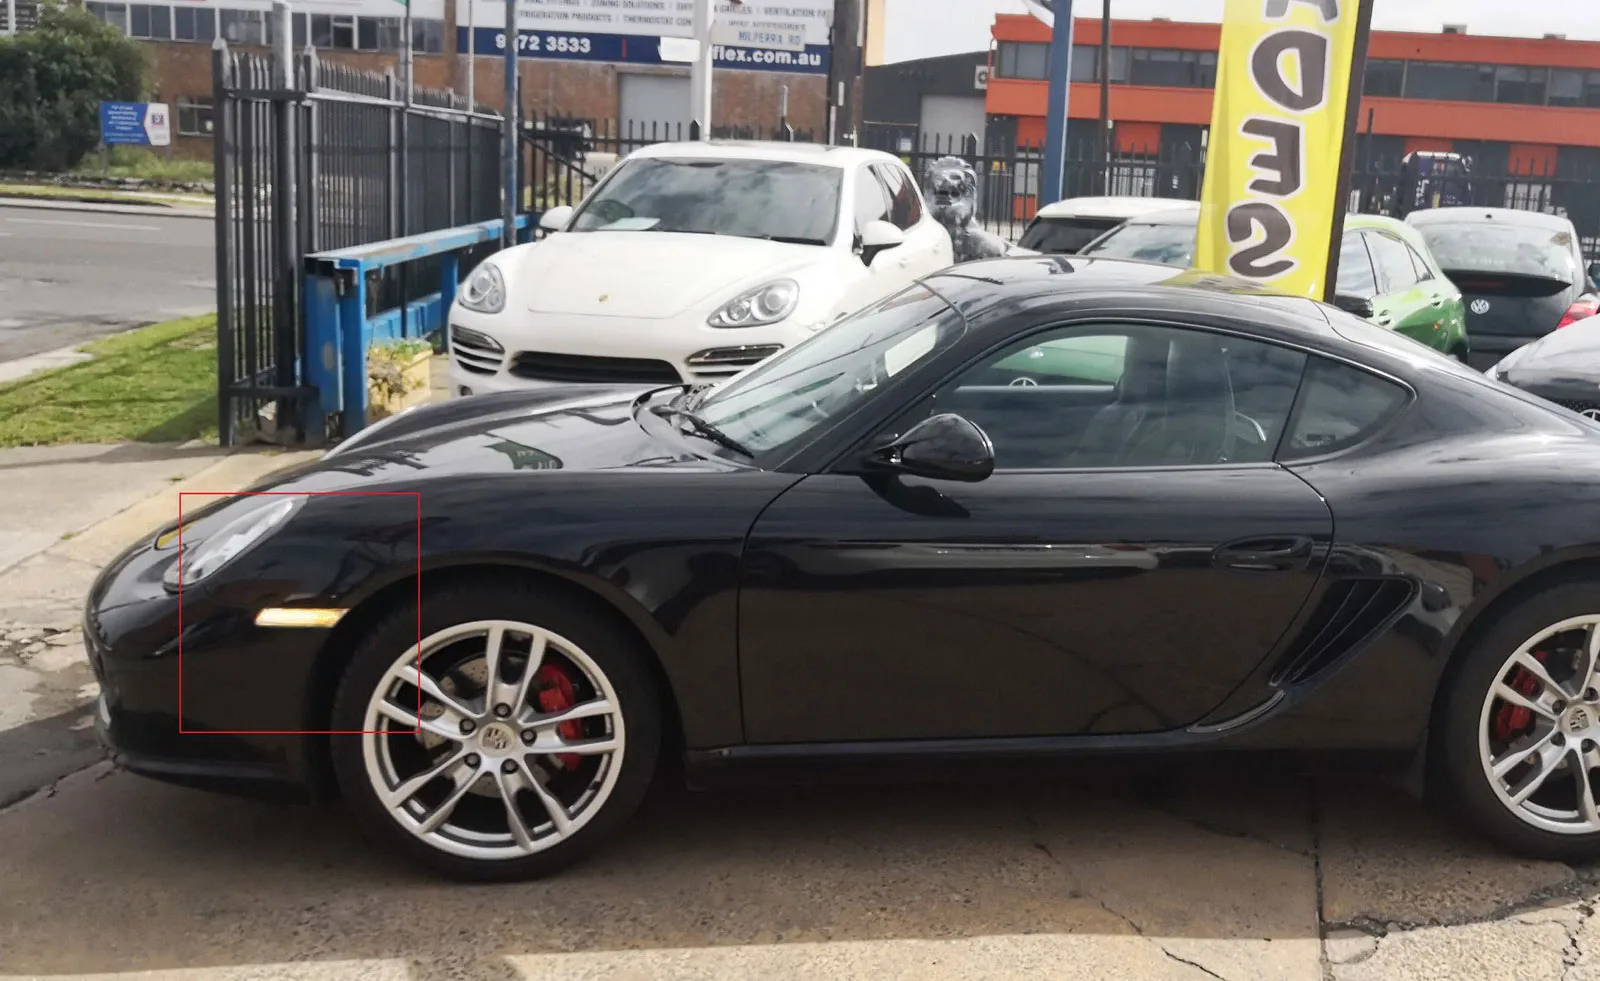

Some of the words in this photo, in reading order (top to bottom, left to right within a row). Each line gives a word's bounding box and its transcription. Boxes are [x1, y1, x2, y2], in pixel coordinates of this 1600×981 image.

[495, 33, 540, 51] 972
[546, 36, 591, 53] 3533
[713, 45, 821, 66] flex.com.au
